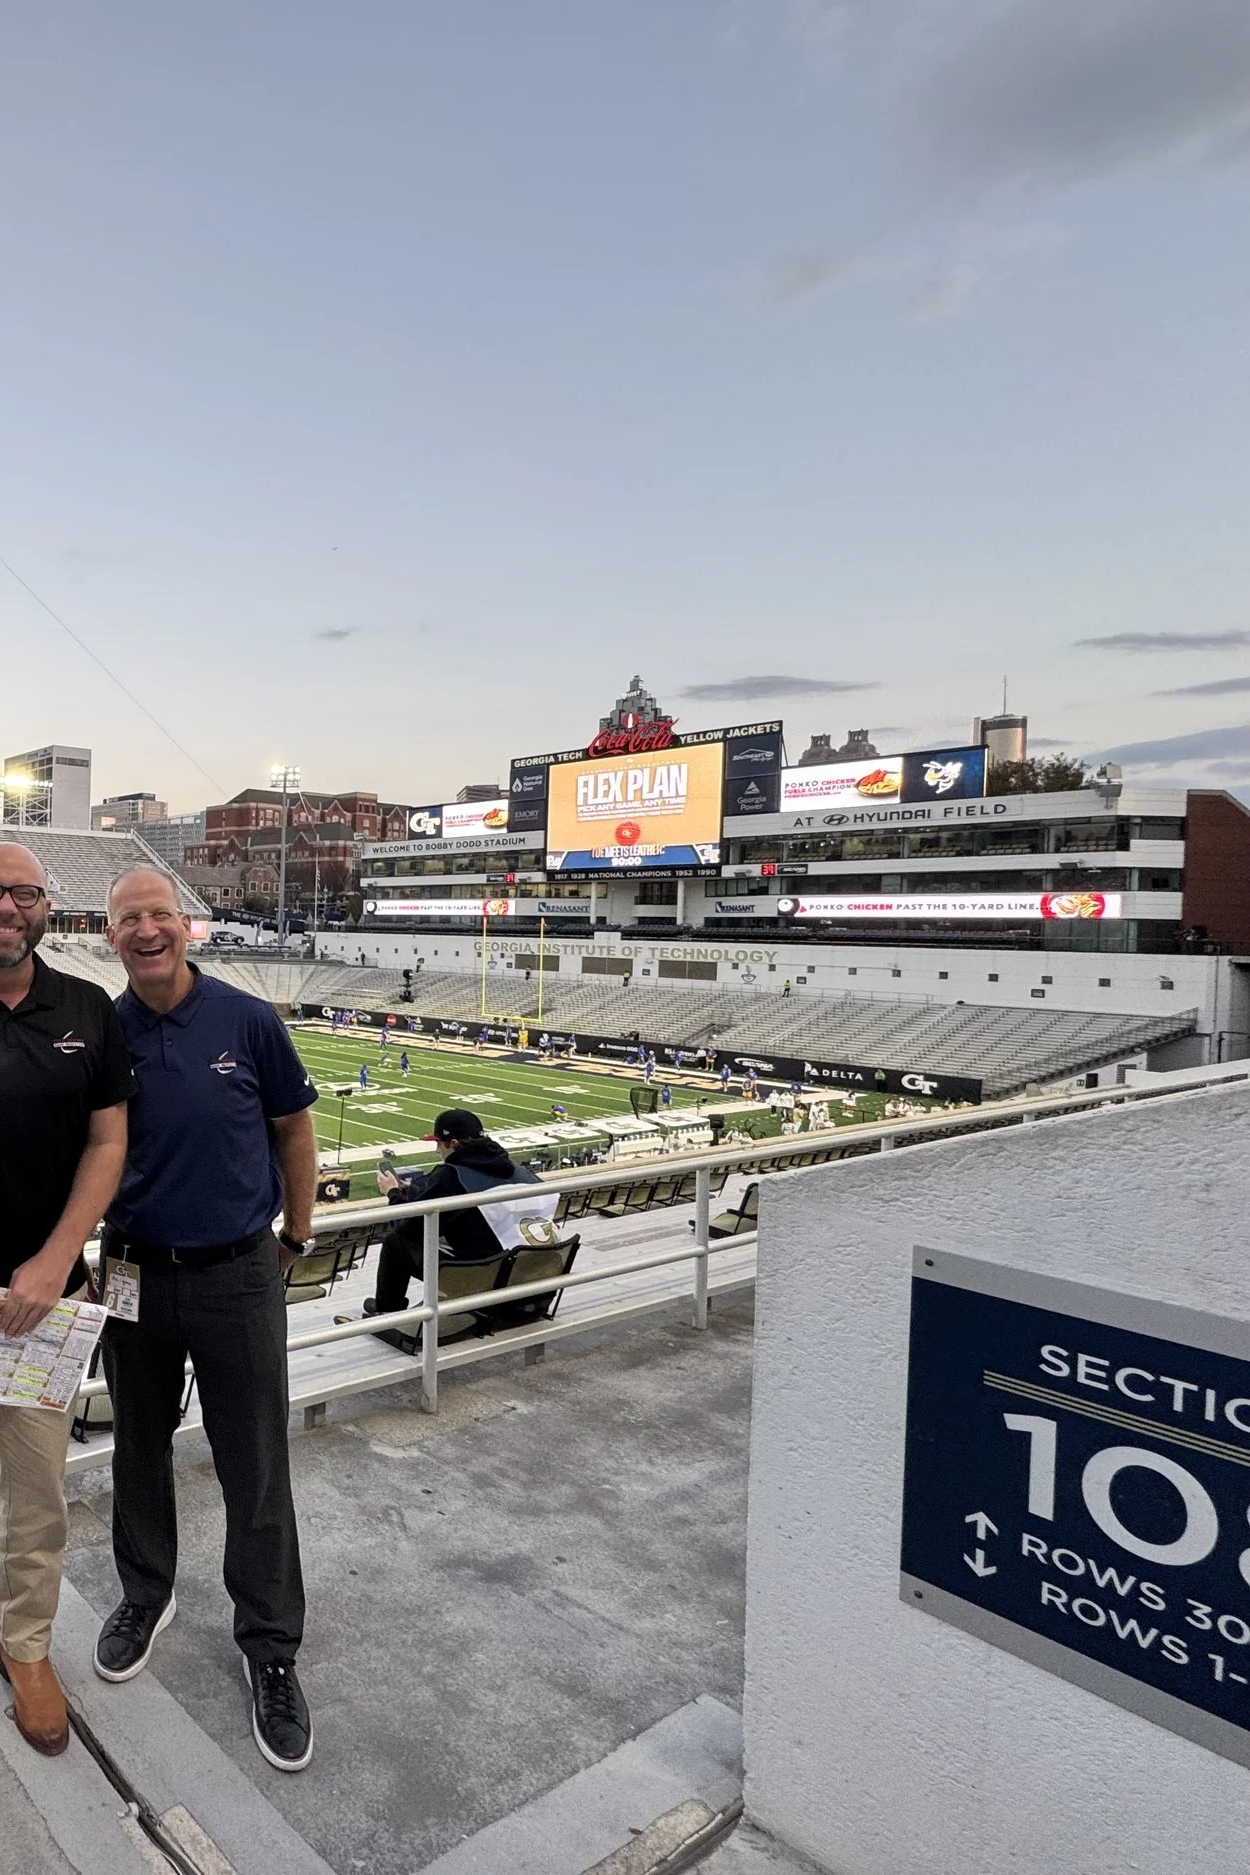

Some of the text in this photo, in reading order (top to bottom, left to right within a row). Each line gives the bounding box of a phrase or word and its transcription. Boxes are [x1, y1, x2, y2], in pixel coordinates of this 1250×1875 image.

[680, 722, 780, 745] YELLOW JACKETS
[514, 751, 583, 768] GEORGIA TECH
[577, 771, 625, 805] FLEX
[628, 763, 688, 801] PLAN
[785, 778, 856, 789] PONKO CHICKEN
[514, 809, 540, 818] EMORY
[578, 805, 596, 813] PICK
[597, 803, 614, 811] ANY
[644, 799, 661, 807] ANY
[665, 797, 686, 805] TIME
[740, 803, 763, 811] Power
[793, 804, 1007, 827] AT HYUNDAI FIELD
[372, 837, 526, 854] WELCOME TO BOBBY DODD STADIUM
[588, 871, 625, 879] NATIONAL
[626, 870, 672, 878] CHAMPIONS
[675, 869, 693, 877] 1952
[547, 905, 591, 913] RENASANT
[721, 904, 756, 913] RENASANT
[952, 903, 1004, 911] 10-YARD
[473, 941, 779, 964] GEORGIA INSTITUTE OF TECHNOLOGY
[822, 1069, 863, 1081] DELTA
[902, 1073, 938, 1095] GT
[1003, 1412, 1250, 1590] 10
[1021, 1532, 1166, 1611] ROWS
[1041, 1580, 1189, 1665] ROWS
